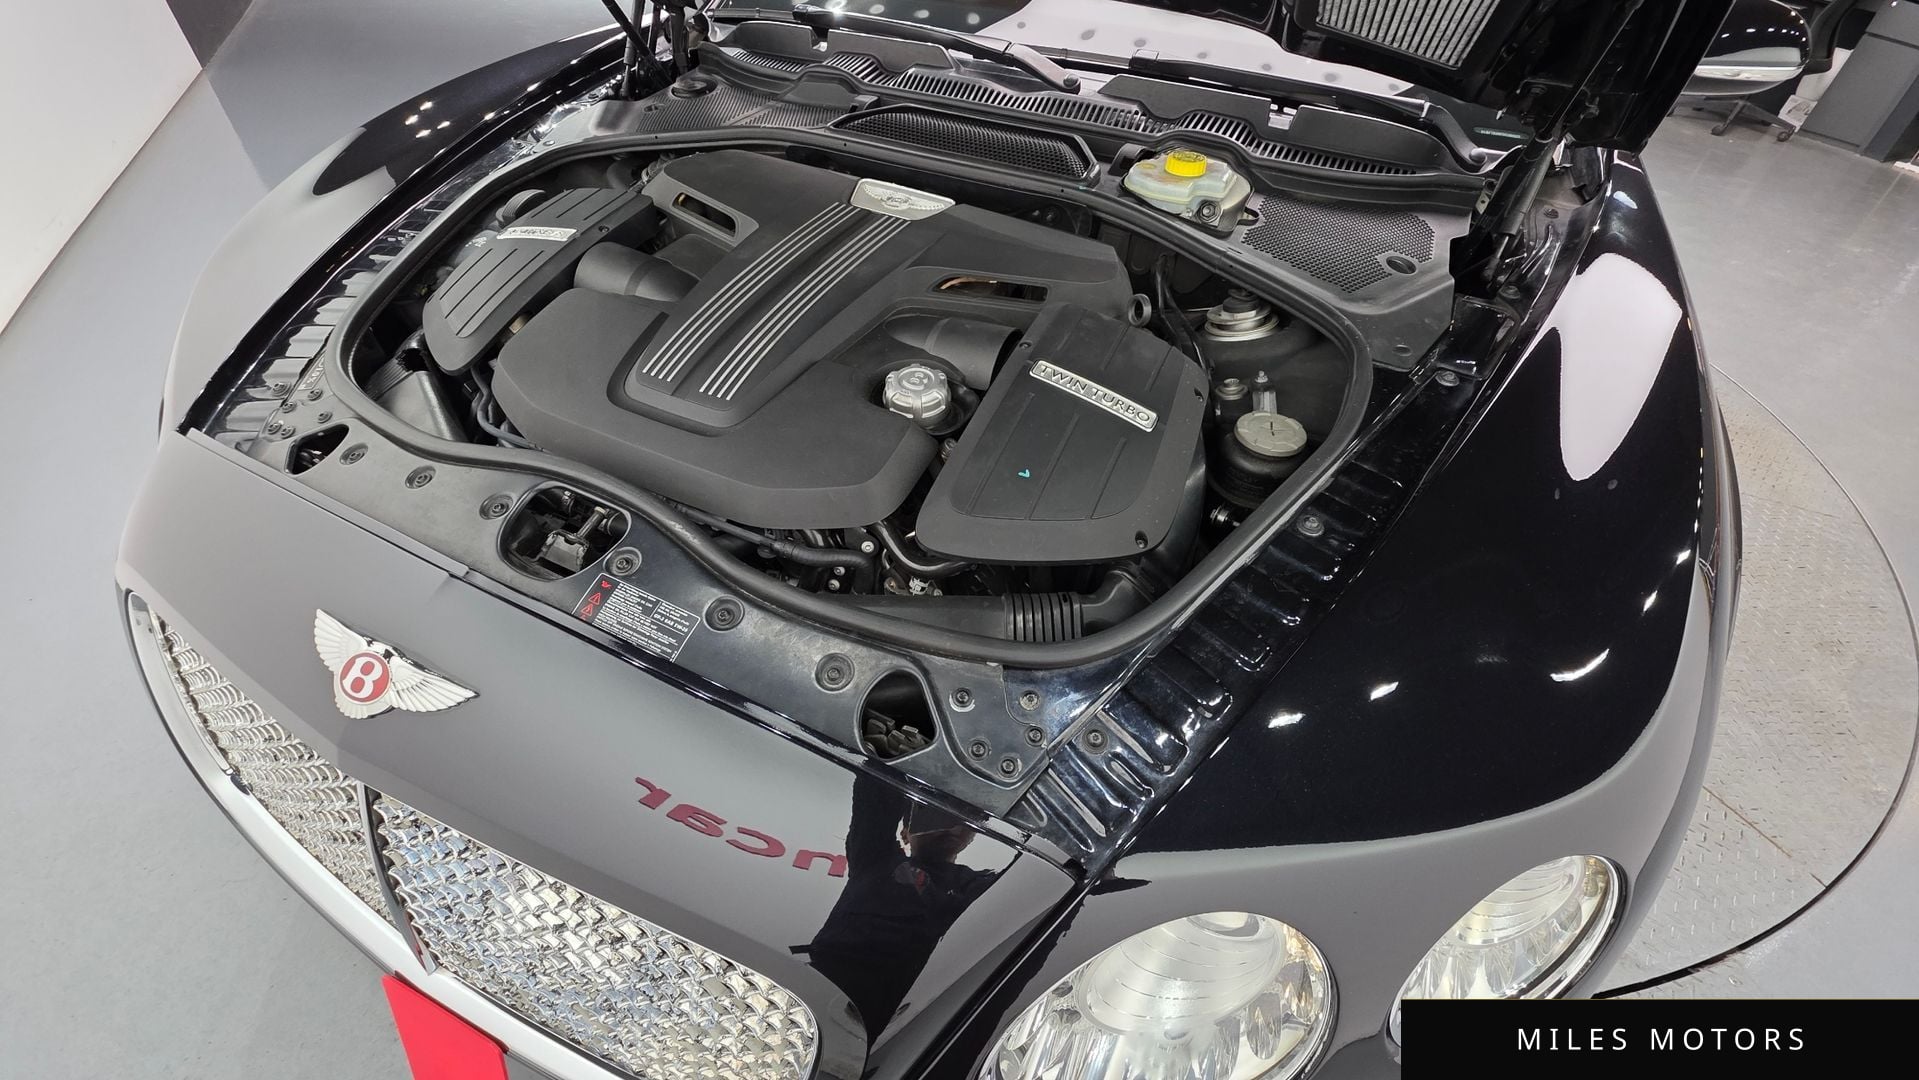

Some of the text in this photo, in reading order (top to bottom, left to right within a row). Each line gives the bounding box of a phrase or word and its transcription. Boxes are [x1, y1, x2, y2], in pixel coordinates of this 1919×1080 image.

[1040, 364, 1150, 422] TWIN TURBO
[342, 656, 383, 699] B
